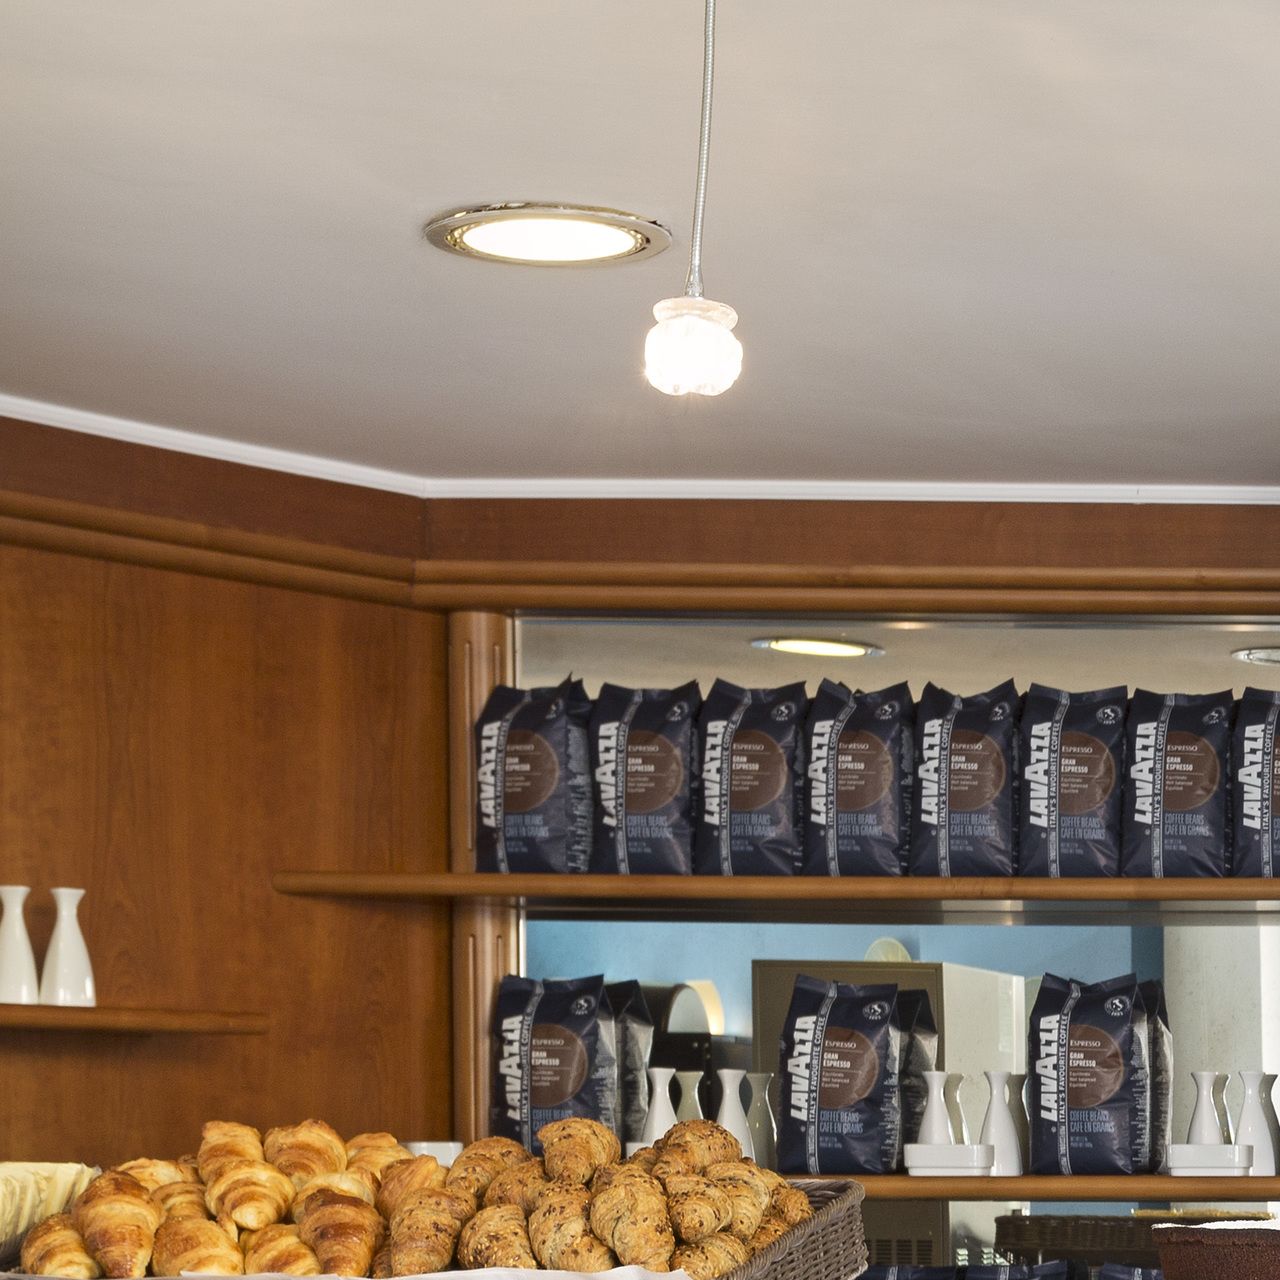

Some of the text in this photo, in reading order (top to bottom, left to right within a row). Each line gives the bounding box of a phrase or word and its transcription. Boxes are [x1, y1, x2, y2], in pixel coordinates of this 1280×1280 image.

[702, 721, 728, 826] LAVAZZA
[808, 720, 835, 825] LAVAZZA
[918, 719, 943, 825] LAVAZZA
[1025, 722, 1051, 828] LAVAZZA
[1131, 722, 1158, 825] LAVAZZA
[1238, 724, 1265, 829] LAVAZZA
[499, 1015, 523, 1120] LAVAZZA
[788, 1016, 817, 1121] LAVAZZA
[811, 1046, 821, 1092] FAVOURITE
[814, 1017, 825, 1045] COFFEE
[823, 1060, 850, 1068] ESPRESSO
[825, 1041, 856, 1049] ESPRESSO
[1036, 1014, 1061, 1121] LAVAZZA
[1059, 1045, 1067, 1092] FAVOURITE
[1060, 1015, 1068, 1045] COFFEE
